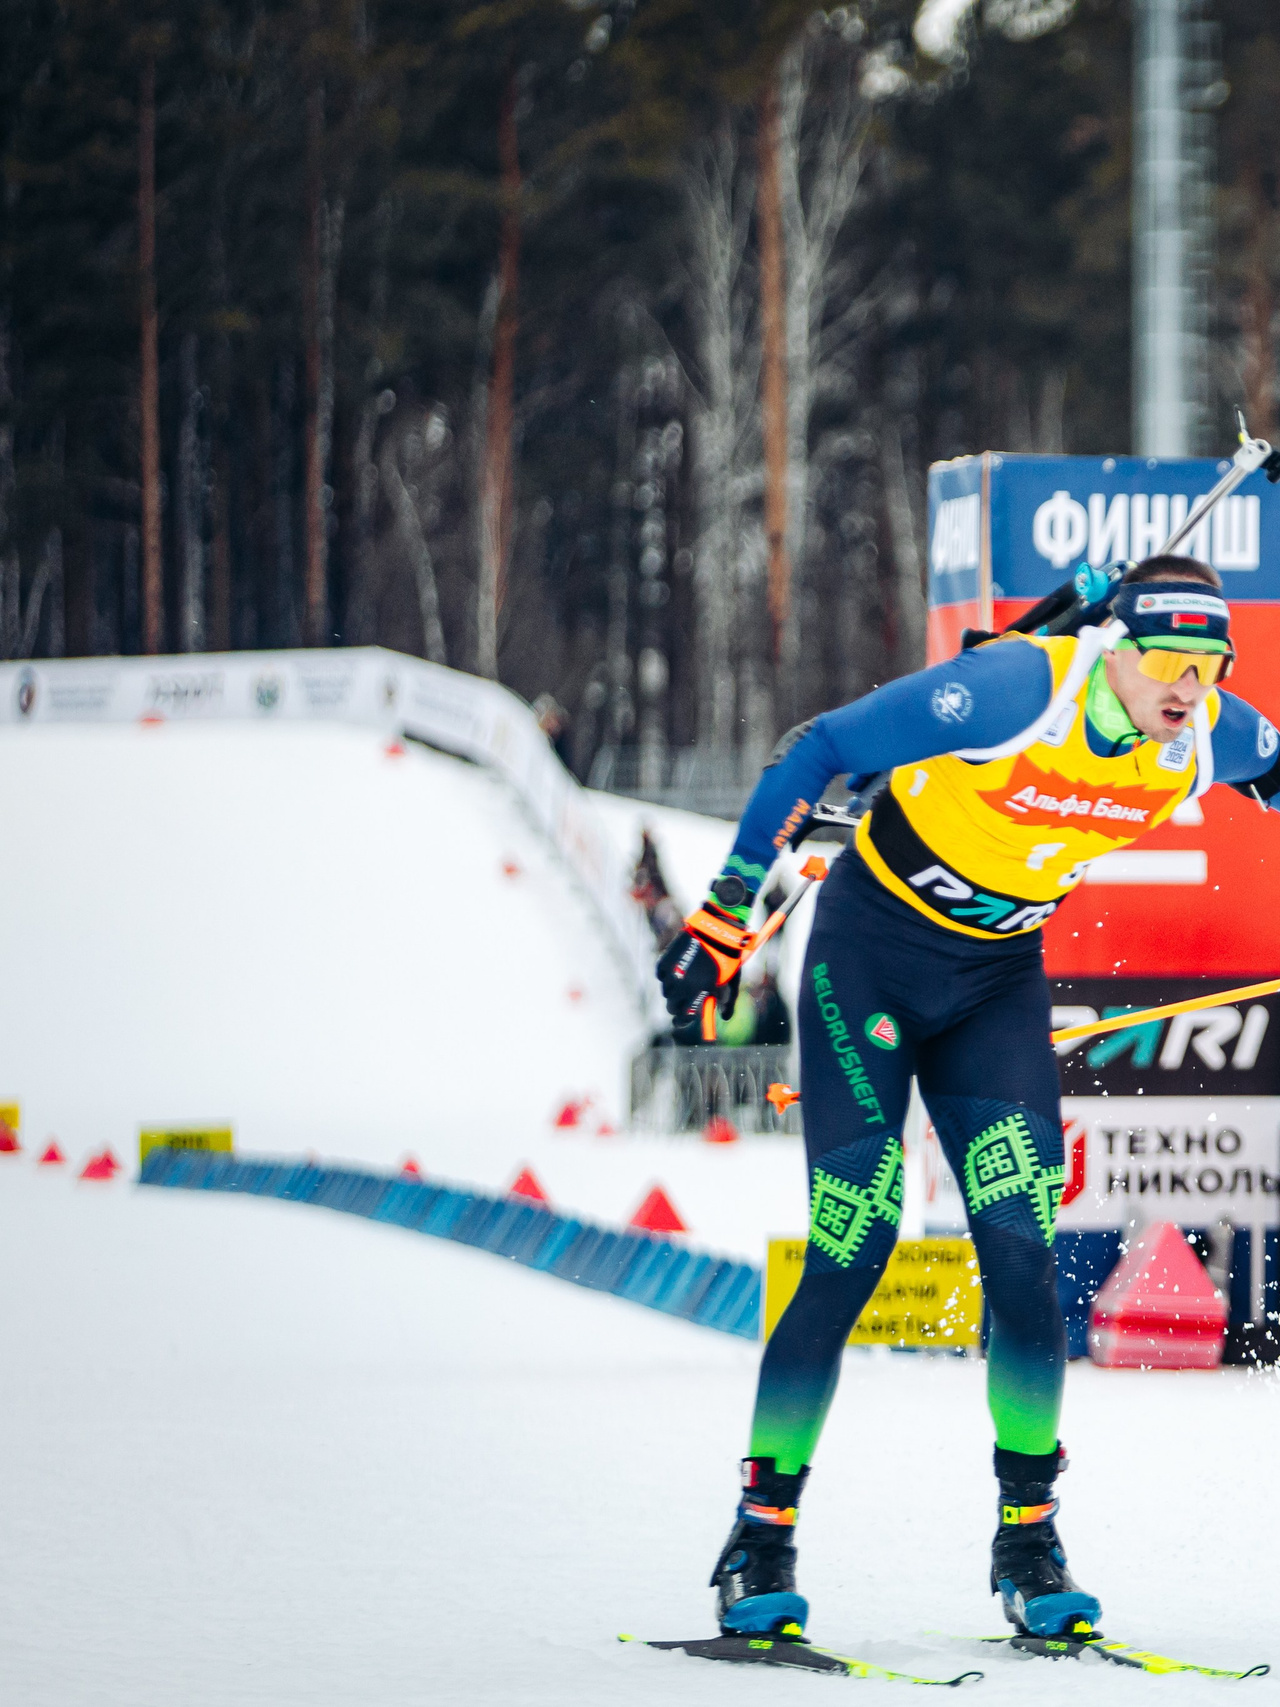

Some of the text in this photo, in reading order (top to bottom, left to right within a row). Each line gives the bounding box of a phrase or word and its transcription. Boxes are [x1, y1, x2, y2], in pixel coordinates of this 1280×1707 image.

[1033, 489, 1261, 572] ФИНИШ
[1007, 785, 1150, 822] Альфа Банк
[907, 864, 1057, 931] PAR
[812, 962, 886, 1125] BELORUSNEFT
[1052, 1003, 1270, 1071] PARI
[1101, 1127, 1243, 1156] ТЕХНО
